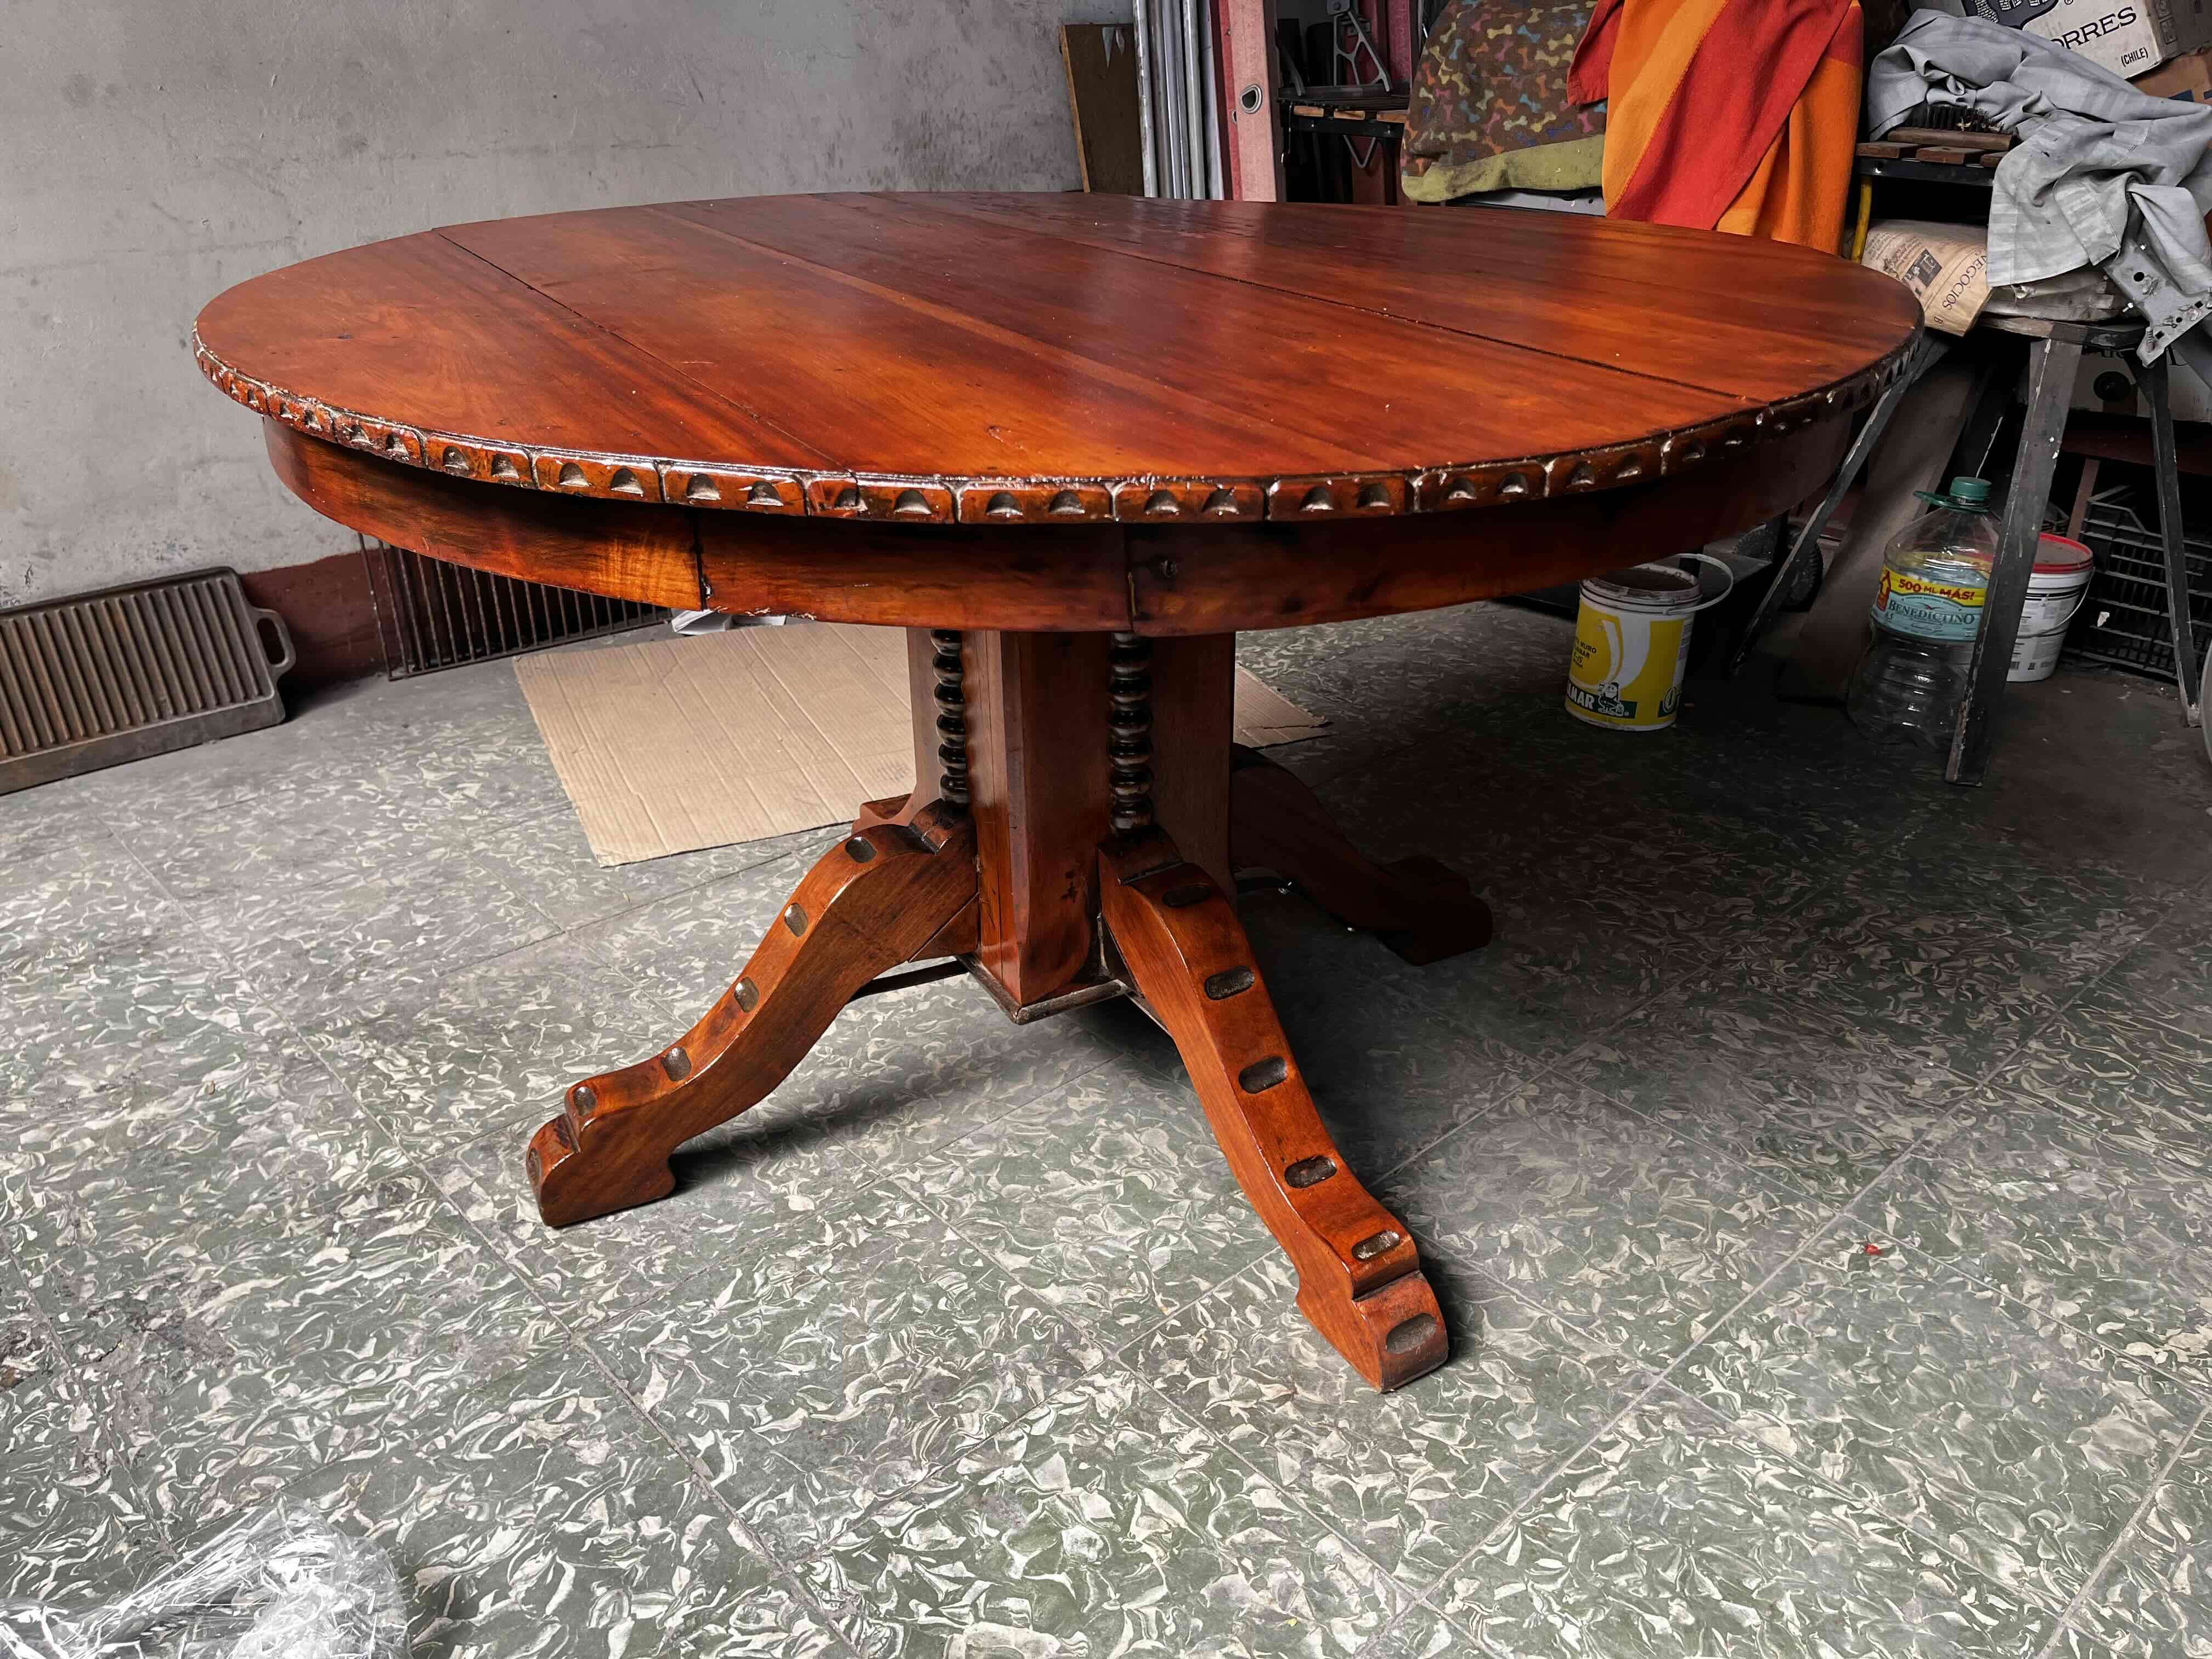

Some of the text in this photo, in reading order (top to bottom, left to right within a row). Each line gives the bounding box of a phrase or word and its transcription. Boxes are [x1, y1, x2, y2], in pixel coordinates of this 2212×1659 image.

[2120, 47, 2149, 67] (CHILE)
[1933, 315, 1944, 324] B
[1899, 579, 1975, 600] 500 ML MÁS!
[1888, 600, 1975, 624] BENEDICTINO
[1581, 641, 1596, 653] MURO
